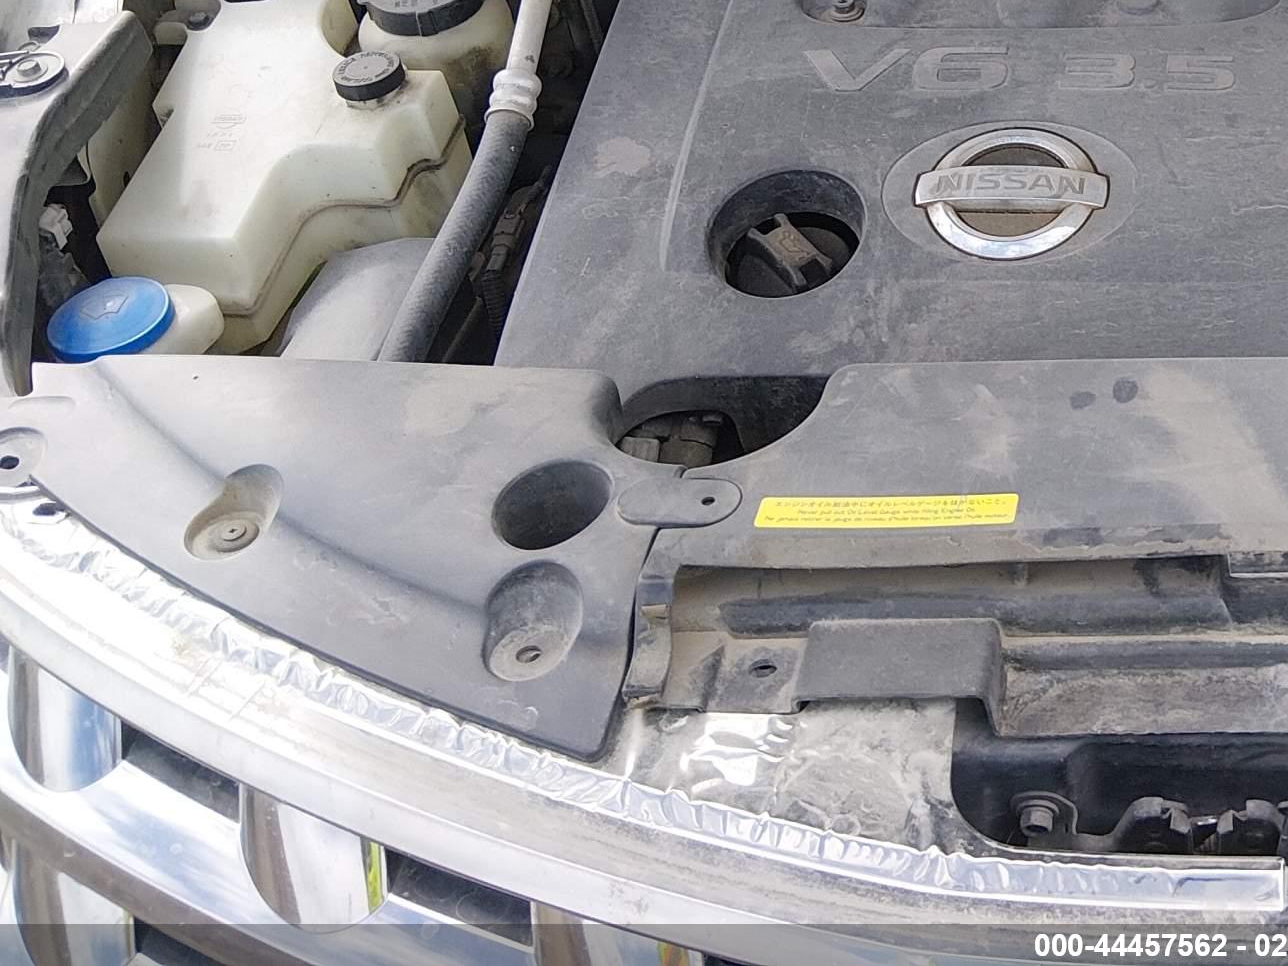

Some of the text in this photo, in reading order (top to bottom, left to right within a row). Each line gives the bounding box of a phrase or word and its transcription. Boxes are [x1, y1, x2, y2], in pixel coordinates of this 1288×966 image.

[803, 47, 1237, 92] V6 3.5
[934, 170, 1087, 196] NISSAN
